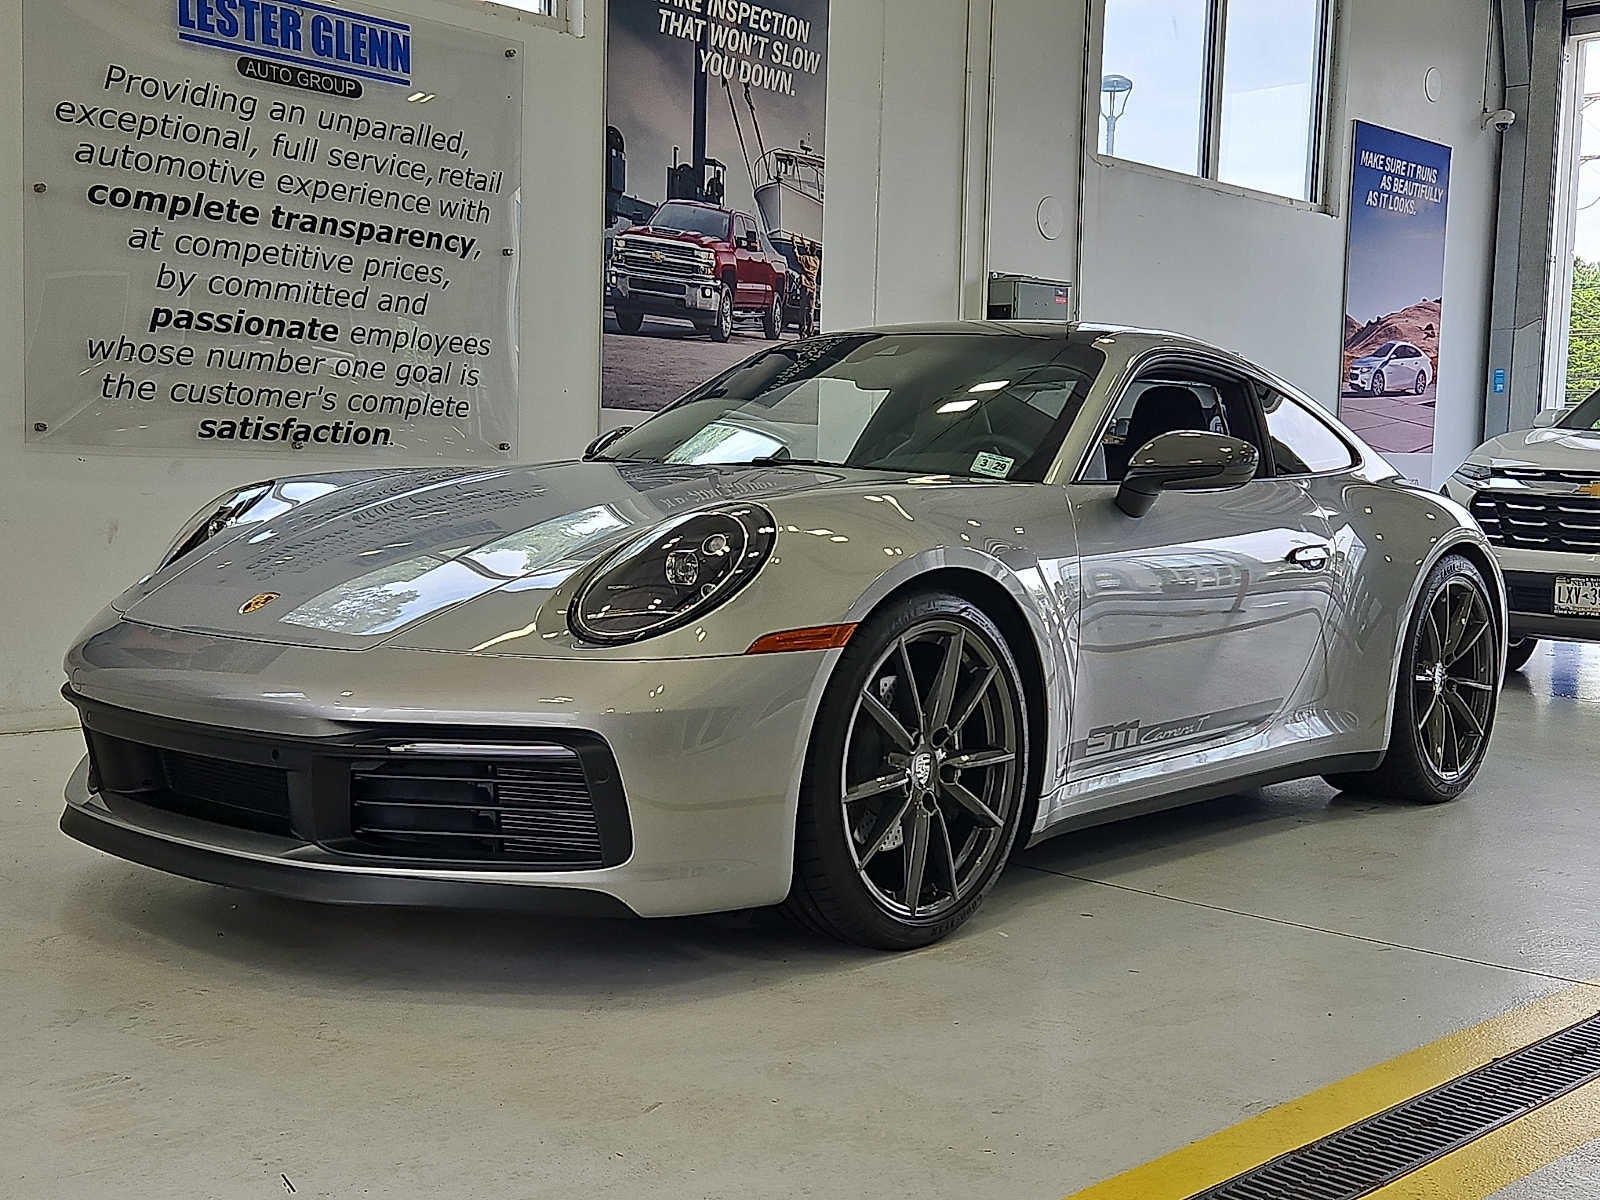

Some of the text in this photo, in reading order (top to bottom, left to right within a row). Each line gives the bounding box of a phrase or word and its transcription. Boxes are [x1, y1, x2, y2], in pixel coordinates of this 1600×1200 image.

[178, 0, 411, 75] LESTER GLENN
[657, 9, 822, 75] THAT WON'T SLOW
[706, 0, 812, 43] INSPECTION
[245, 61, 356, 94] AUTO GROUP
[699, 49, 797, 97] YOU DOWN.
[104, 64, 470, 160] Providing an unparalled,
[55, 100, 503, 194] exceptional, full service, retail
[1360, 150, 1438, 184] MAKE SURE IT RUNS
[74, 142, 490, 224] automotive experience with
[1366, 190, 1417, 215] AS IT LOOKS.
[1380, 174, 1444, 203] AS BEAUTIFULLY
[87, 183, 481, 260] complete transparency,
[128, 226, 451, 290] at competitive prices,
[155, 262, 429, 316] by committed and
[148, 306, 491, 357] passionate employees
[87, 335, 480, 387] whose number one goal is
[102, 373, 470, 420] the customer's complete
[198, 415, 394, 446] satisfaction.
[980, 458, 988, 467] 3
